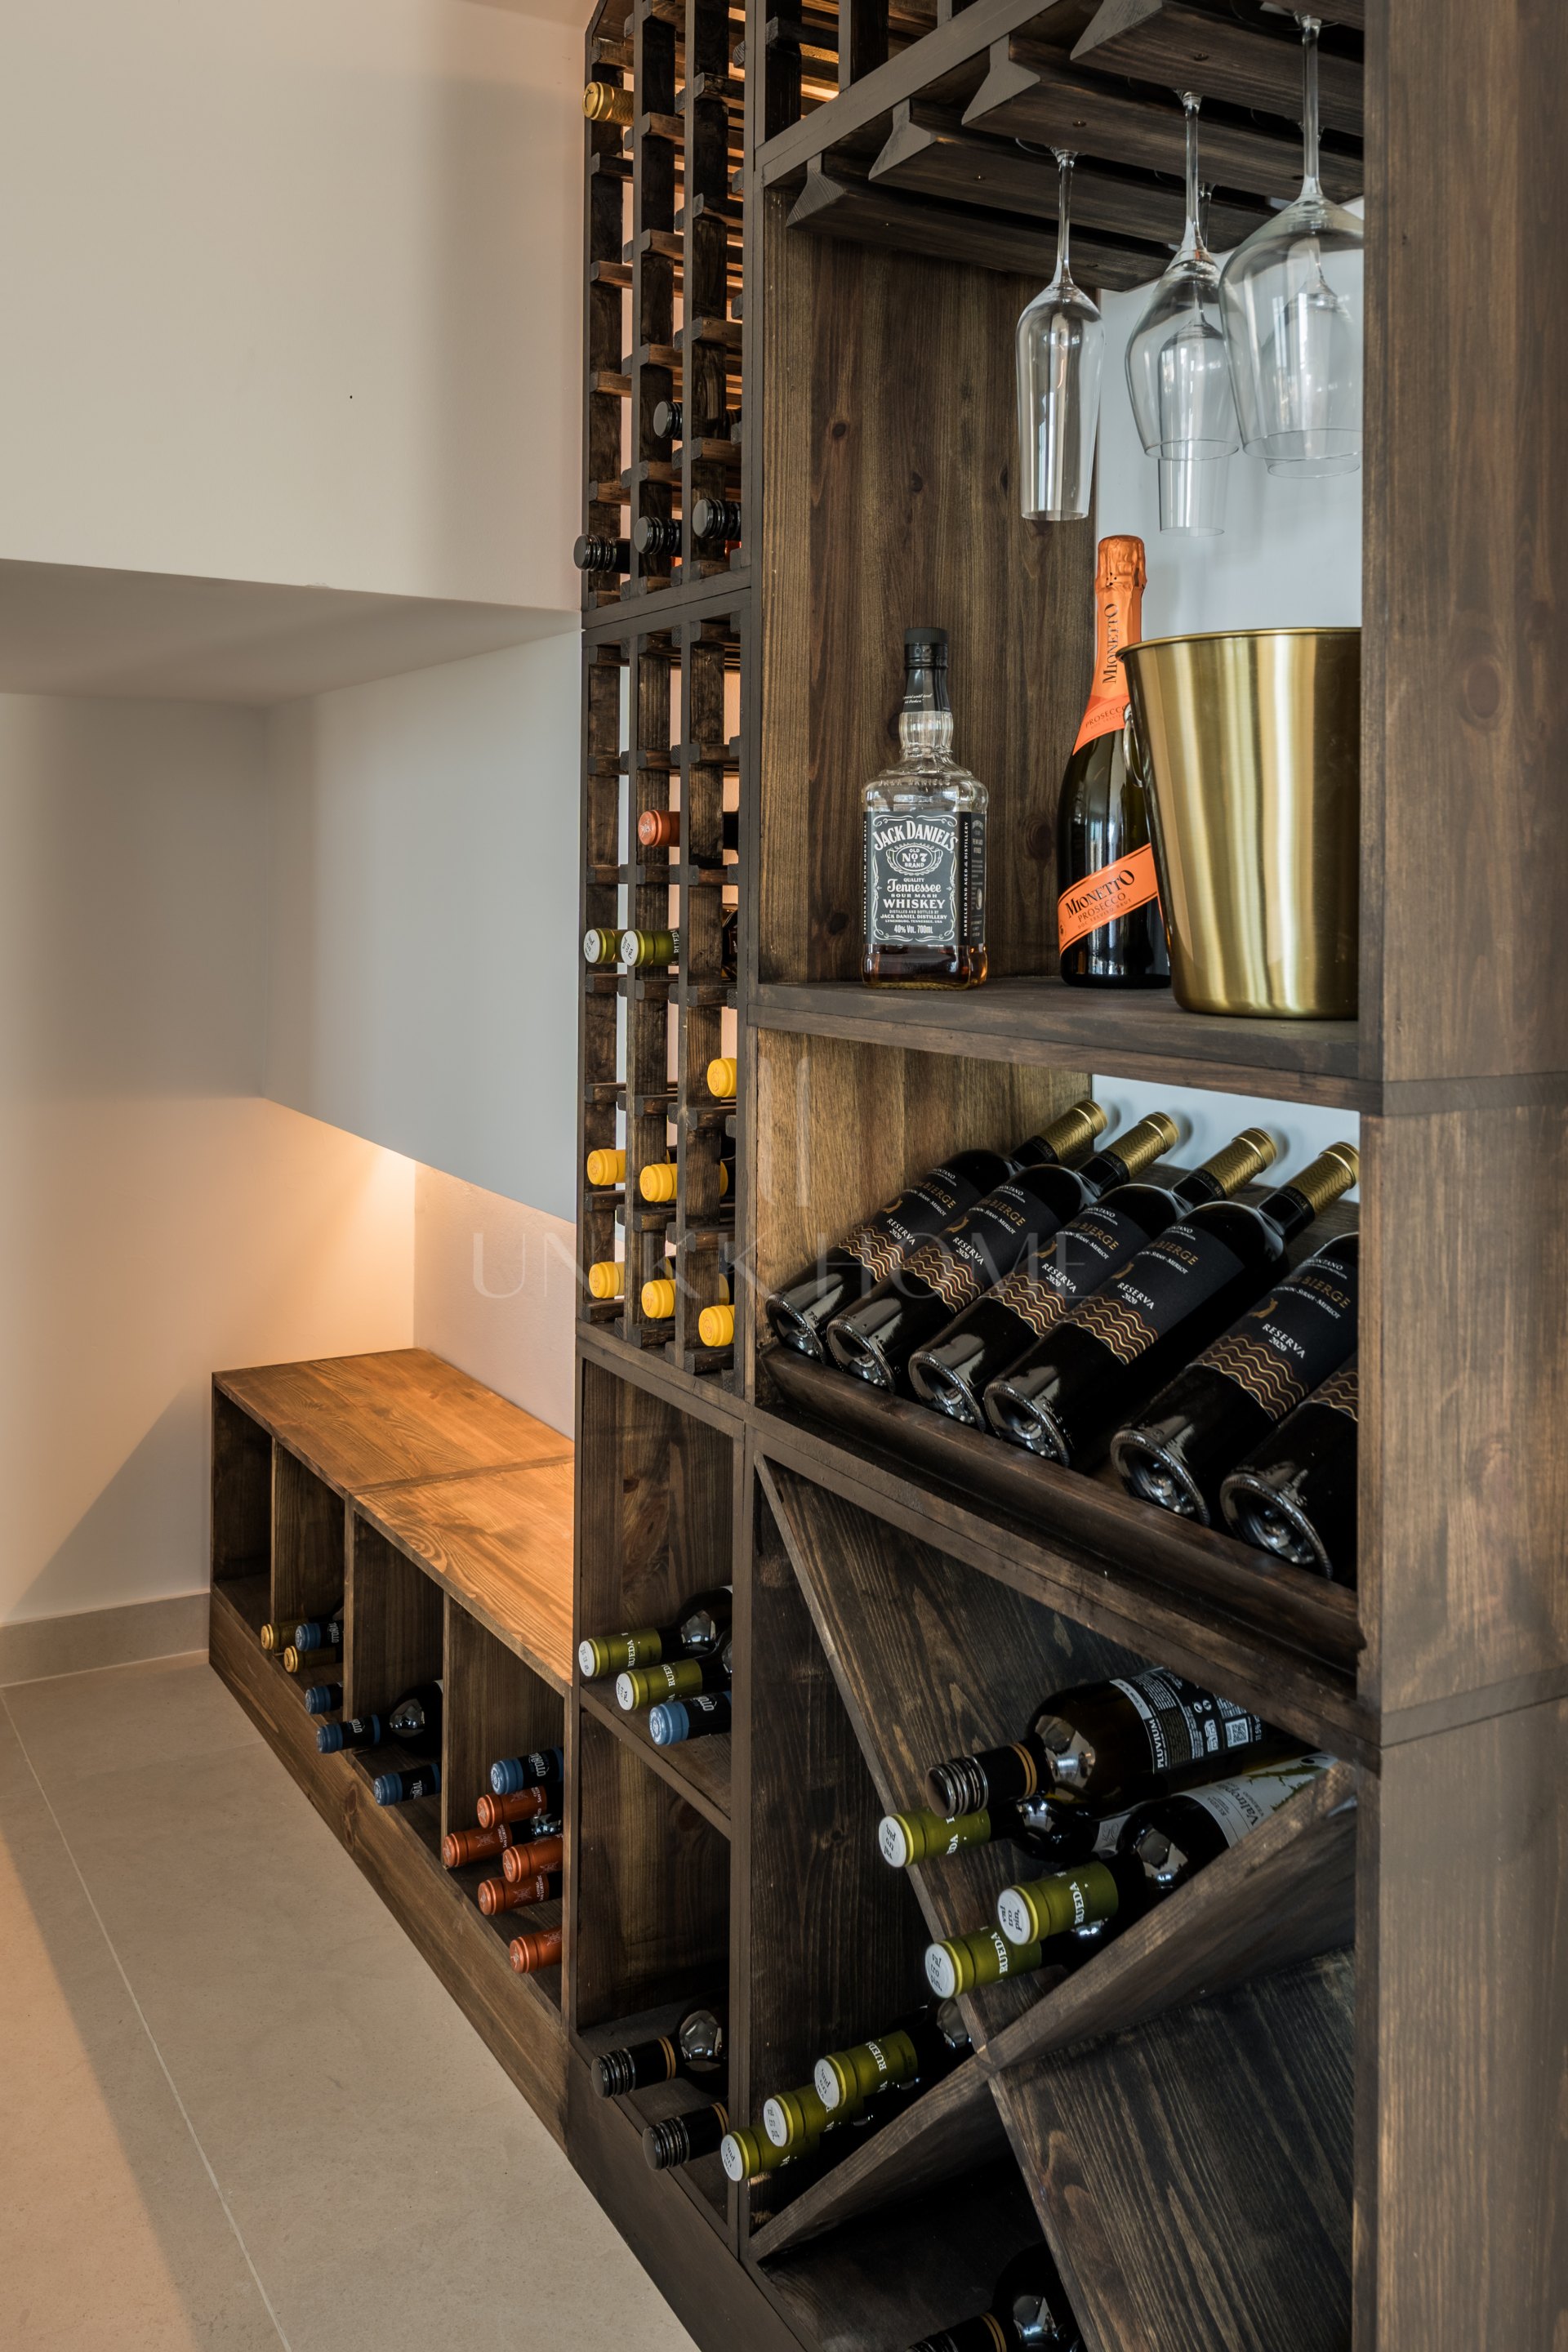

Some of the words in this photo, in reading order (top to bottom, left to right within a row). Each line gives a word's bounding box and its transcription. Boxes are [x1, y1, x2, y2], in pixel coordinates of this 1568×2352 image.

[1102, 603, 1119, 684] MIONETTO
[872, 825, 906, 851] JACK
[906, 820, 959, 852] DANIEL'S
[887, 878, 942, 893] Tennessee
[1065, 870, 1134, 919] MIONETTO
[883, 899, 946, 909] WHISKEY
[1078, 893, 1125, 922] PROSECCO
[894, 924, 906, 933] 40%
[923, 1182, 957, 1209] BIERGE
[989, 1199, 1026, 1226] BIERGE
[886, 1218, 915, 1245] RESERVA
[890, 1228, 902, 1240] 2020
[1078, 1222, 1120, 1250] BIERGE
[952, 1237, 984, 1265] RESERVA
[956, 1247, 970, 1259] 2020
[1156, 1241, 1199, 1265] BIERGE
[1042, 1262, 1077, 1293] RESERVA
[1046, 1274, 1062, 1288] 2020
[1117, 1281, 1154, 1310] RESERVA
[1122, 1292, 1138, 1305] 2020
[1300, 1276, 1351, 1310] BIERGE
[1262, 1323, 1306, 1359] RESERVA
[1268, 1336, 1287, 1351] 2020
[627, 1639, 636, 1668] RUEDA
[1148, 1719, 1164, 1768] PLUVIUM
[1069, 1881, 1085, 1925] RUEDA
[1013, 1909, 1022, 1932] pin.
[932, 1953, 942, 1967] val
[990, 1931, 1009, 1975] RUEDA
[930, 1964, 940, 1977] tro
[930, 1974, 942, 1992] pin.
